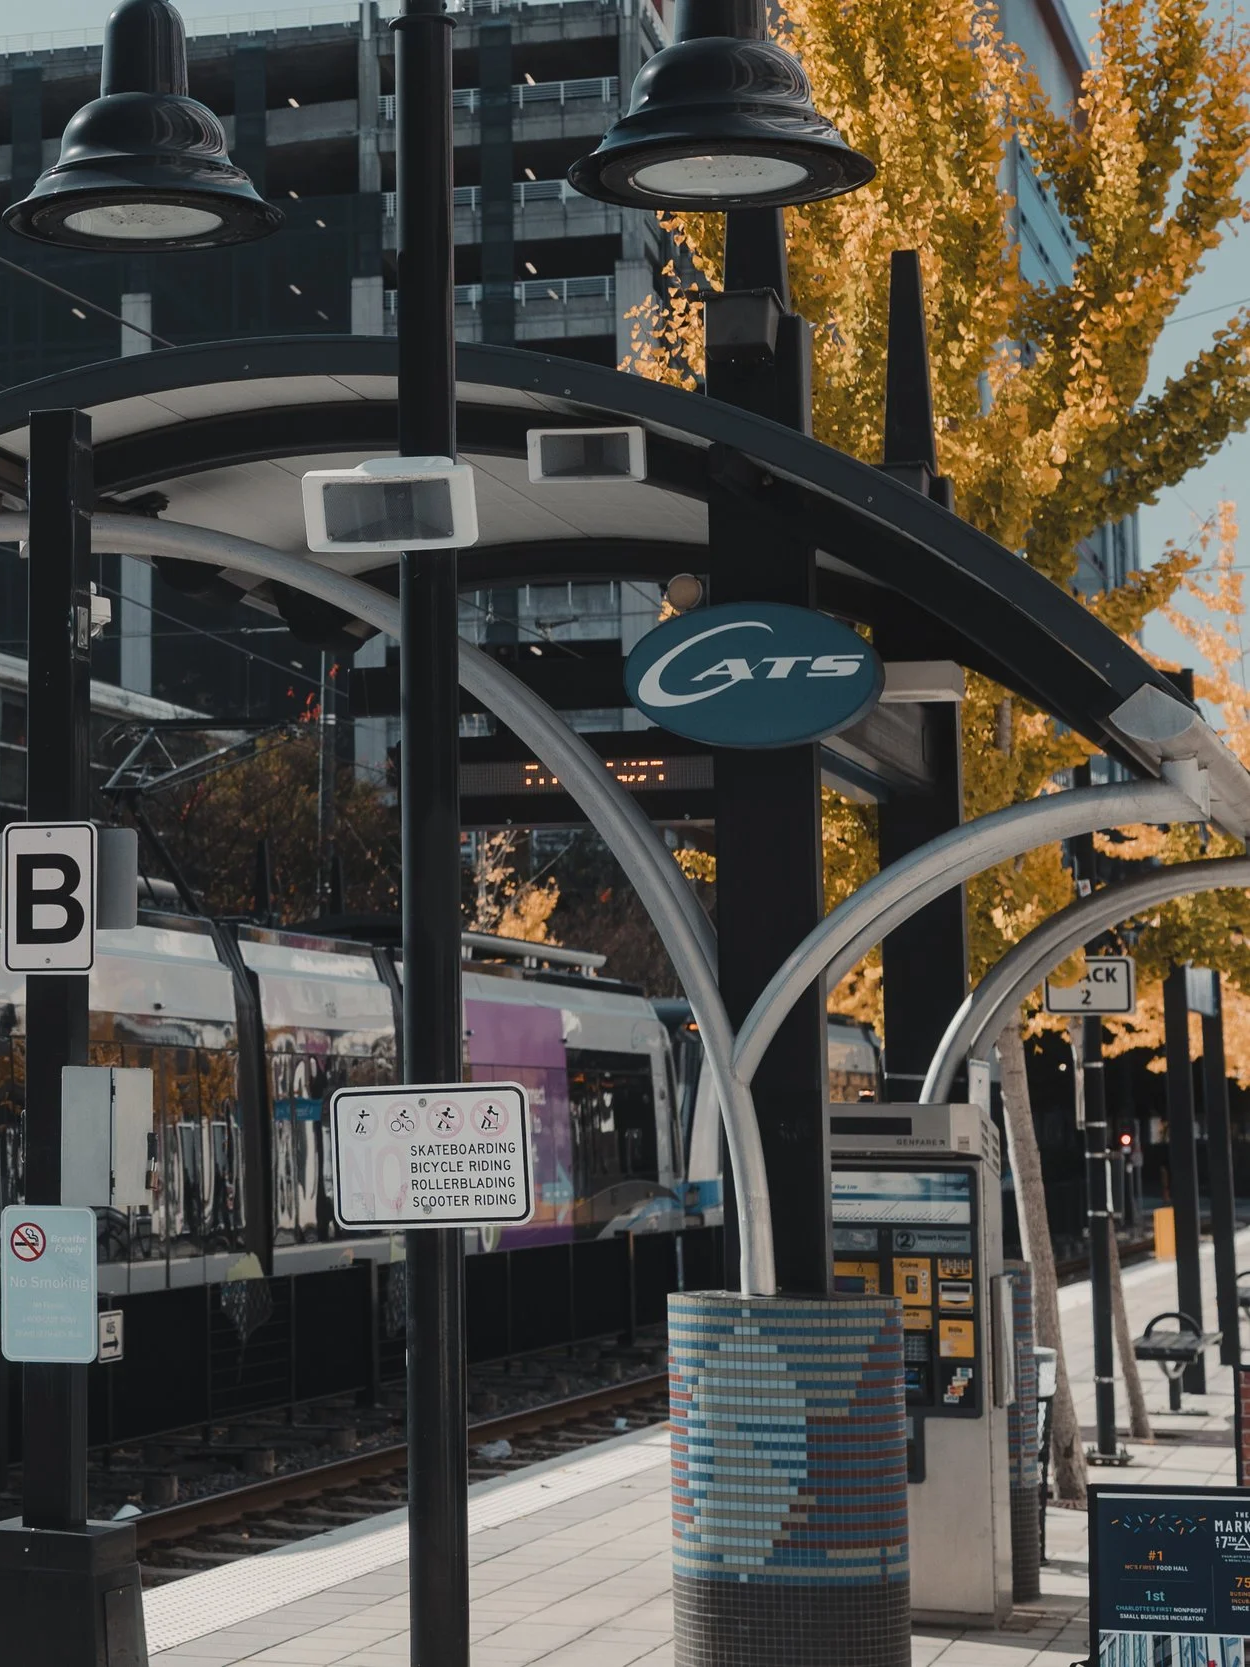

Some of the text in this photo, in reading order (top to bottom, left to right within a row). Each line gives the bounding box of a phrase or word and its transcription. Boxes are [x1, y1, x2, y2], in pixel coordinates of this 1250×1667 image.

[637, 620, 865, 707] CATS
[16, 853, 85, 945] B
[1081, 989, 1092, 1005] 2
[410, 1142, 516, 1157] SKATEBOARDING
[411, 1159, 511, 1173] BICYCLE RIDING
[411, 1176, 516, 1190] ROLLERBLADING
[412, 1193, 517, 1208] SCOOTER RIDING
[900, 1232, 911, 1249] 2
[10, 1276, 89, 1292] No Smoking
[1214, 1520, 1250, 1533] MARK
[1148, 1550, 1163, 1561] #1
[1145, 1590, 1165, 1601] 1st
